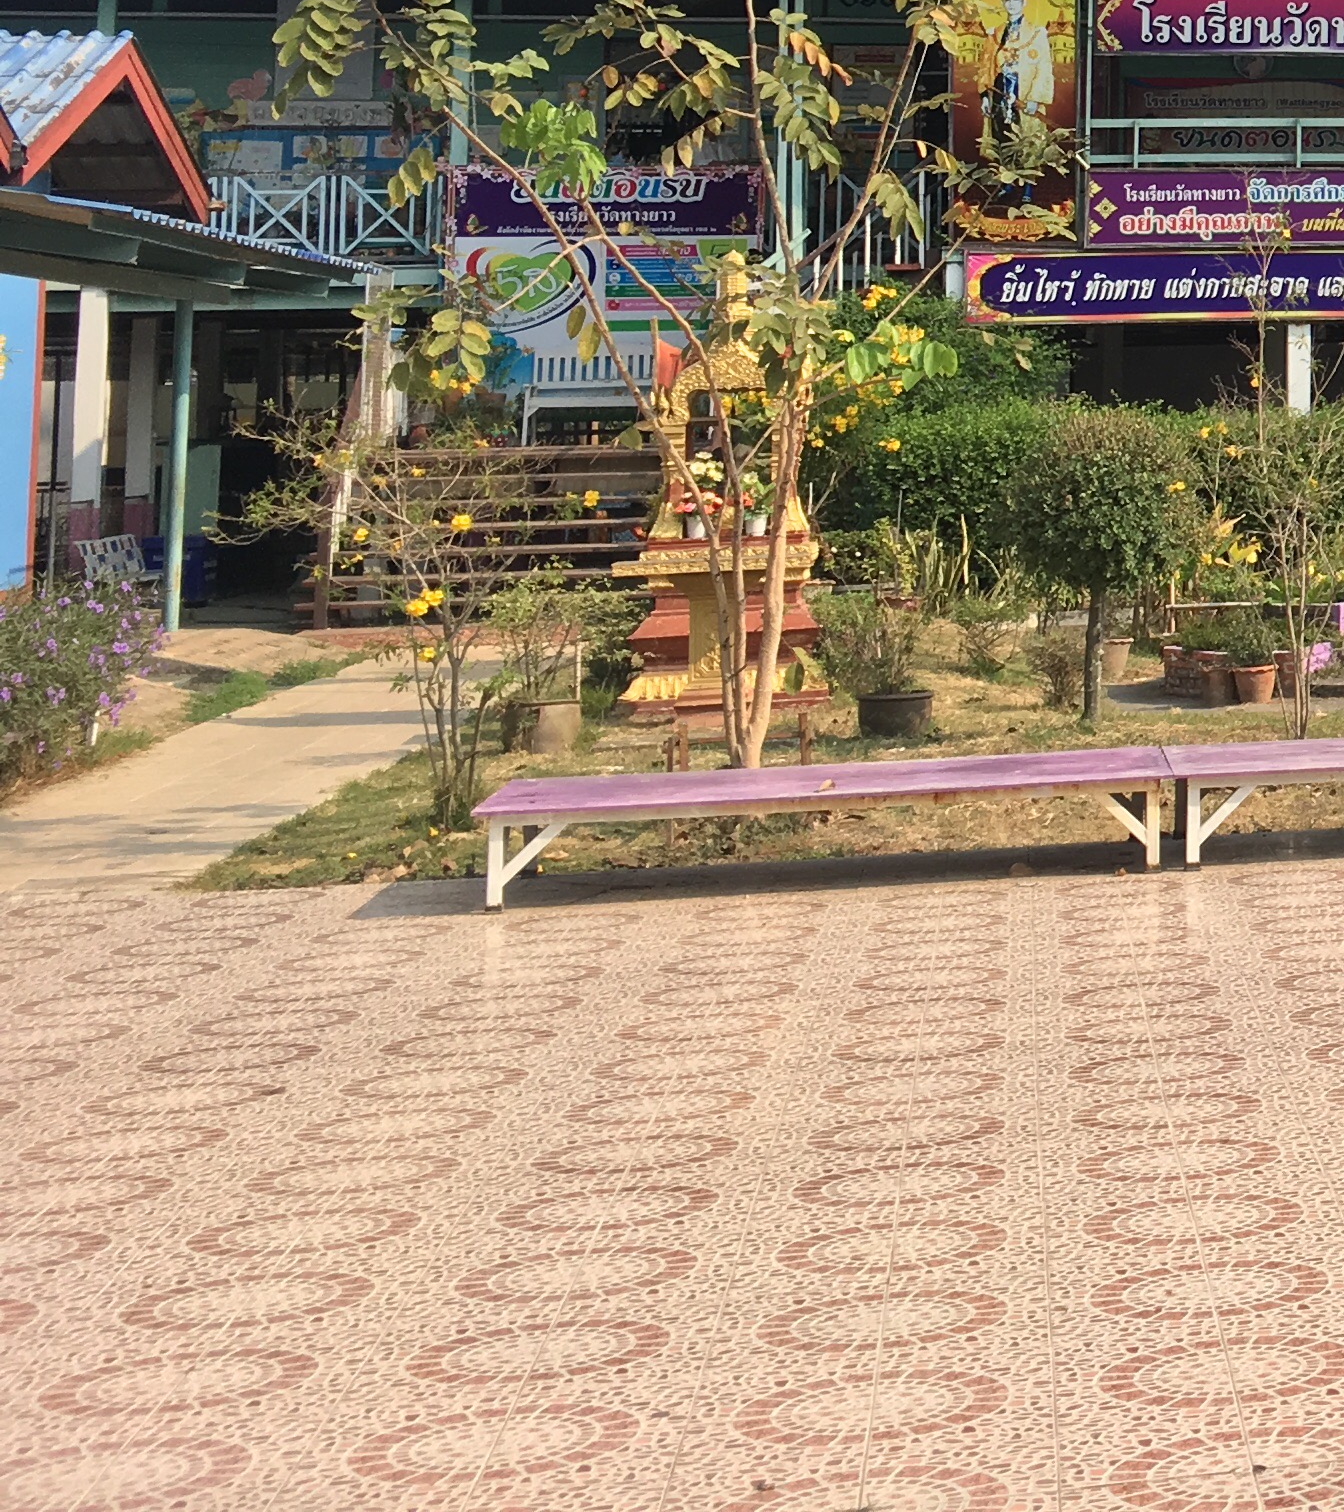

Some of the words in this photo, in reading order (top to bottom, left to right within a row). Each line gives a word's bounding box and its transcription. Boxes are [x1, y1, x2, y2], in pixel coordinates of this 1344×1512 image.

[1123, 183, 1241, 202] โรงเรียนวัดทางยาว
[1083, 273, 1156, 301] ทักทาย
